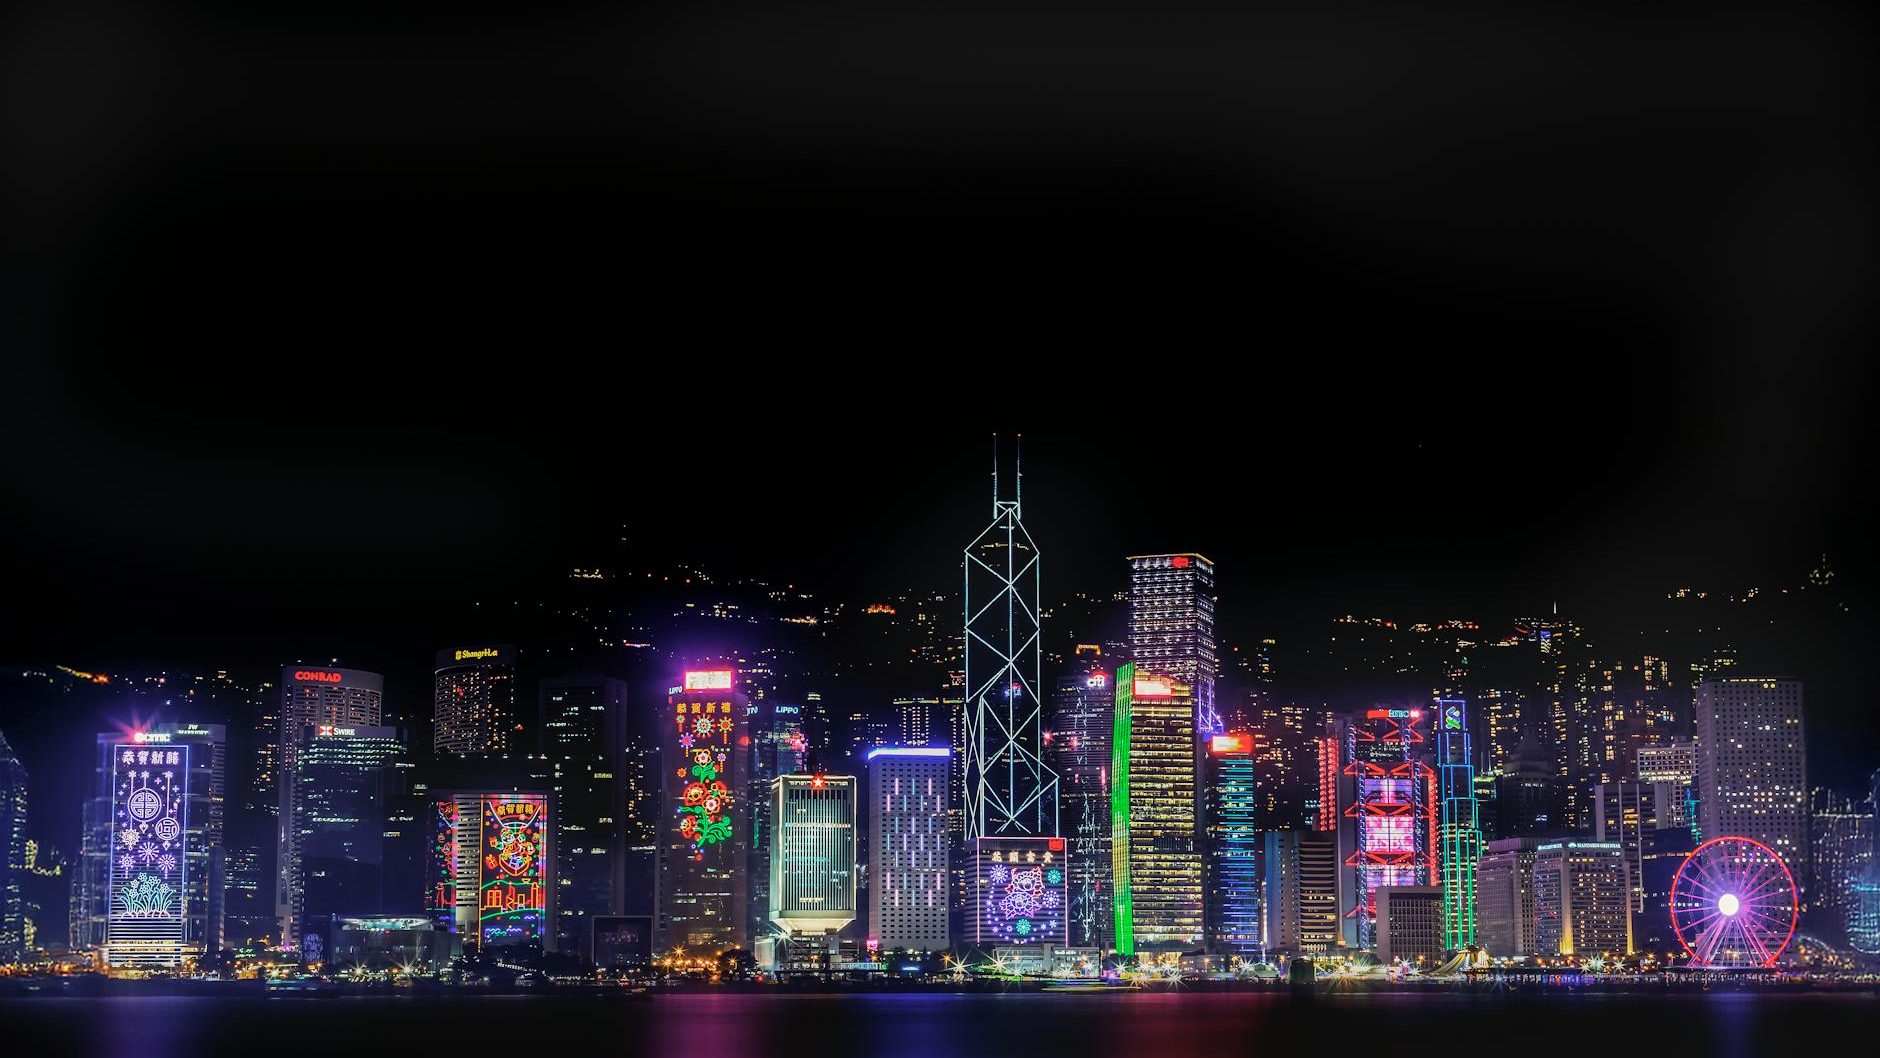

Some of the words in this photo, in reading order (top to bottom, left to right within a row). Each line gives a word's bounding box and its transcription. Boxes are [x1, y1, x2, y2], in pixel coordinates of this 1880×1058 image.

[294, 671, 342, 683] CONRAD
[775, 705, 799, 715] LIPPO
[1388, 710, 1410, 718] HSBC
